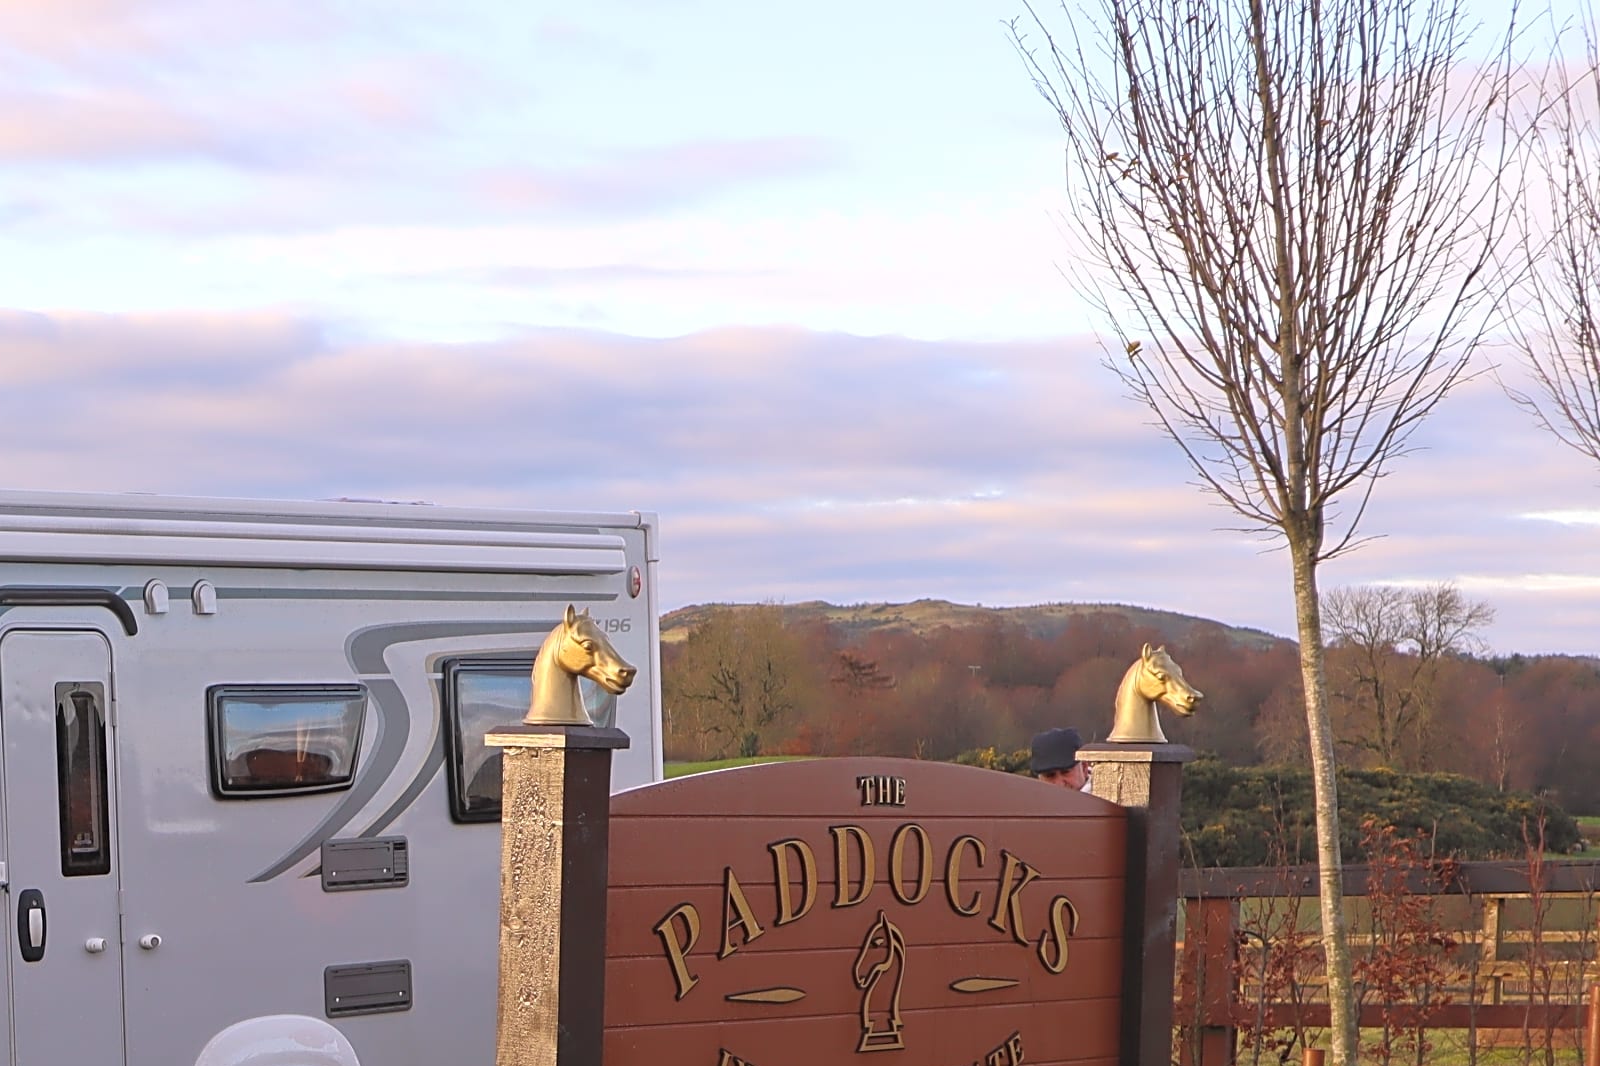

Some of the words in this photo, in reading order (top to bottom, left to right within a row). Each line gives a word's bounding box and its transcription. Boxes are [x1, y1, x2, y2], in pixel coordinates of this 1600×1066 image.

[604, 618, 632, 633] 196
[856, 775, 907, 808] THE
[653, 822, 1082, 1002] PADDOCKS
